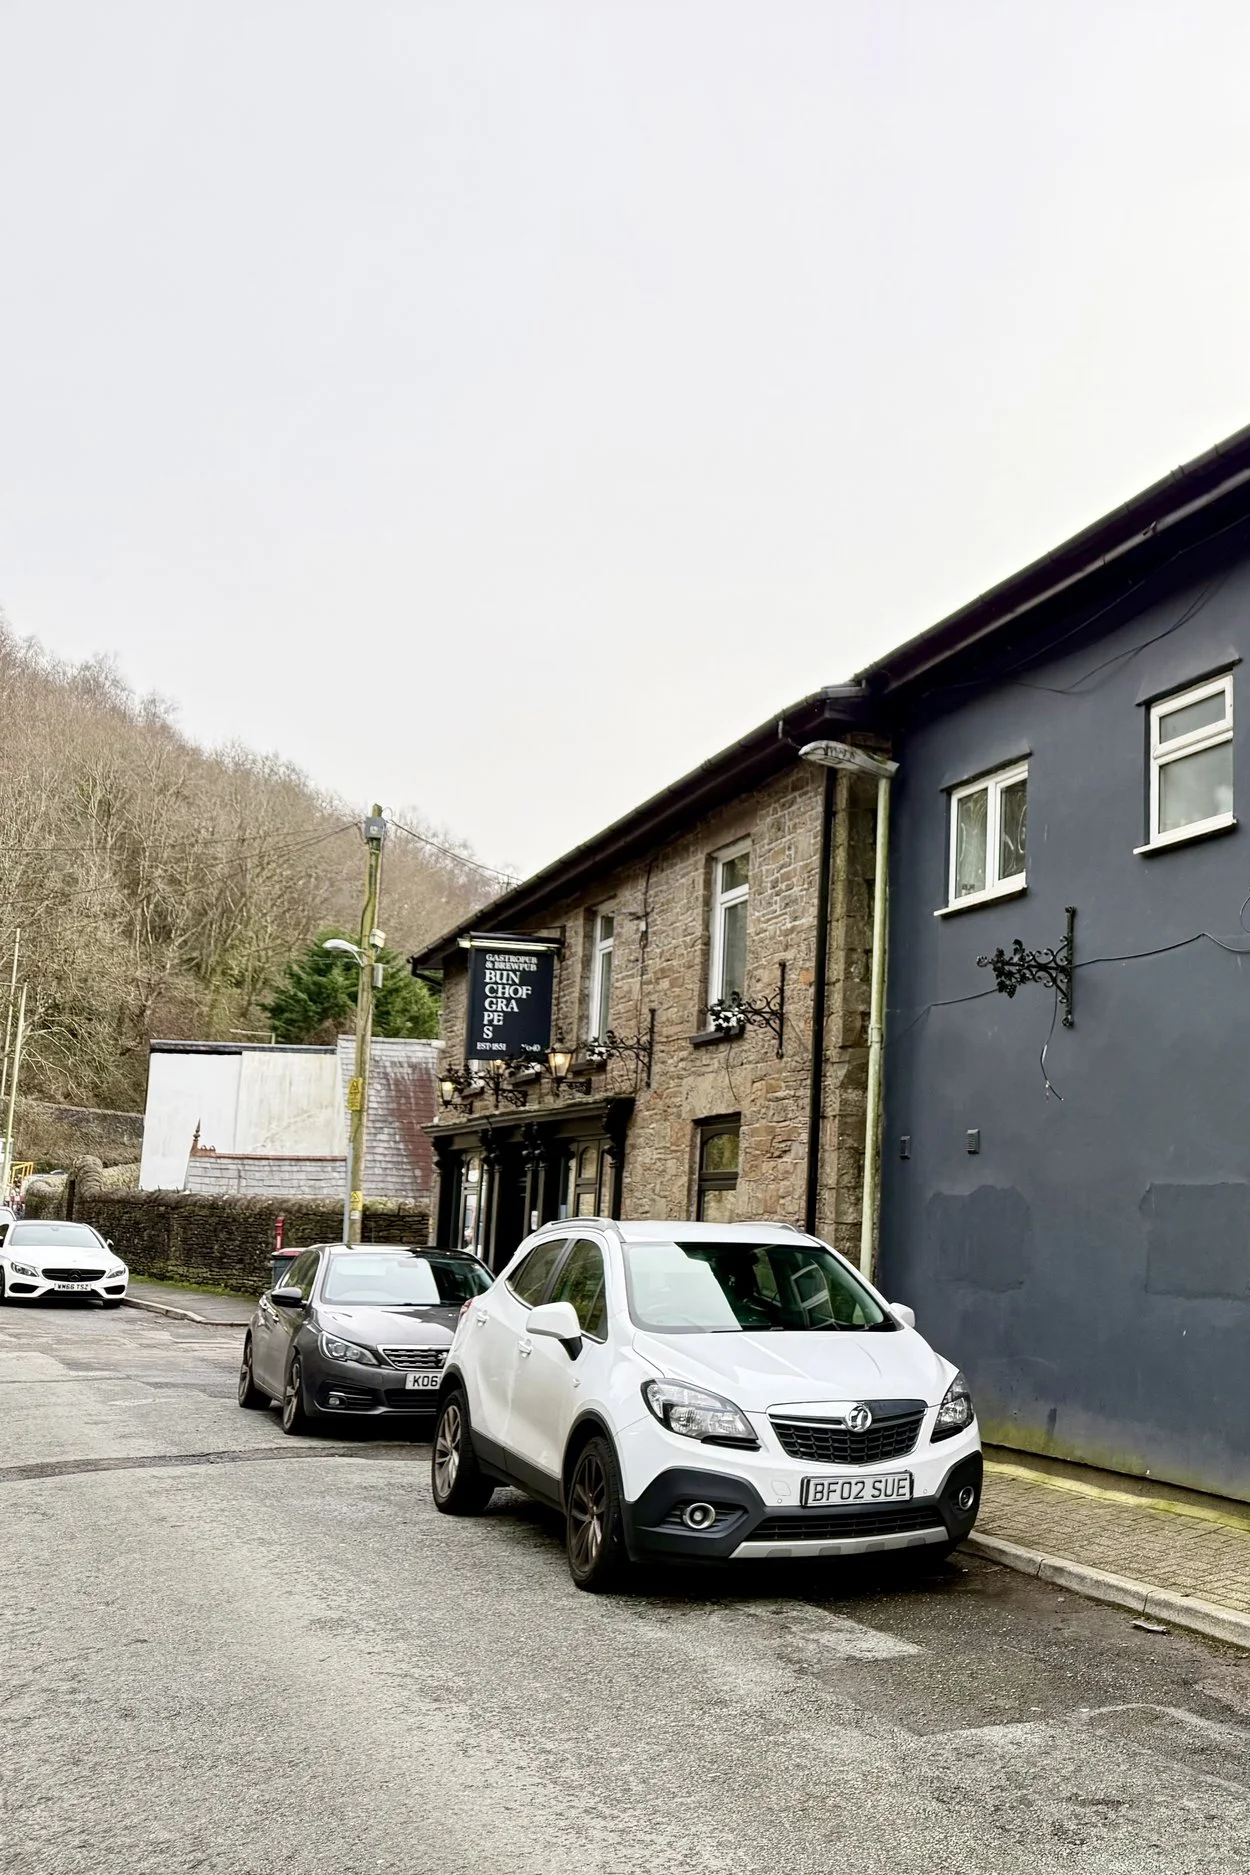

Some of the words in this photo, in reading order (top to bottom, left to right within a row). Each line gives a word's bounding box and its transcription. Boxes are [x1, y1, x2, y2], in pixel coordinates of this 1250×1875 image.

[485, 953, 538, 964] GASTROPUB
[494, 961, 537, 971] BREWPUB
[483, 969, 520, 984] BUN
[484, 983, 532, 999] CHOF
[484, 997, 519, 1012] GRA
[483, 1011, 503, 1026] PE
[482, 1025, 493, 1039] S
[812, 1481, 866, 1502] BF02
[871, 1478, 908, 1499] SUE
